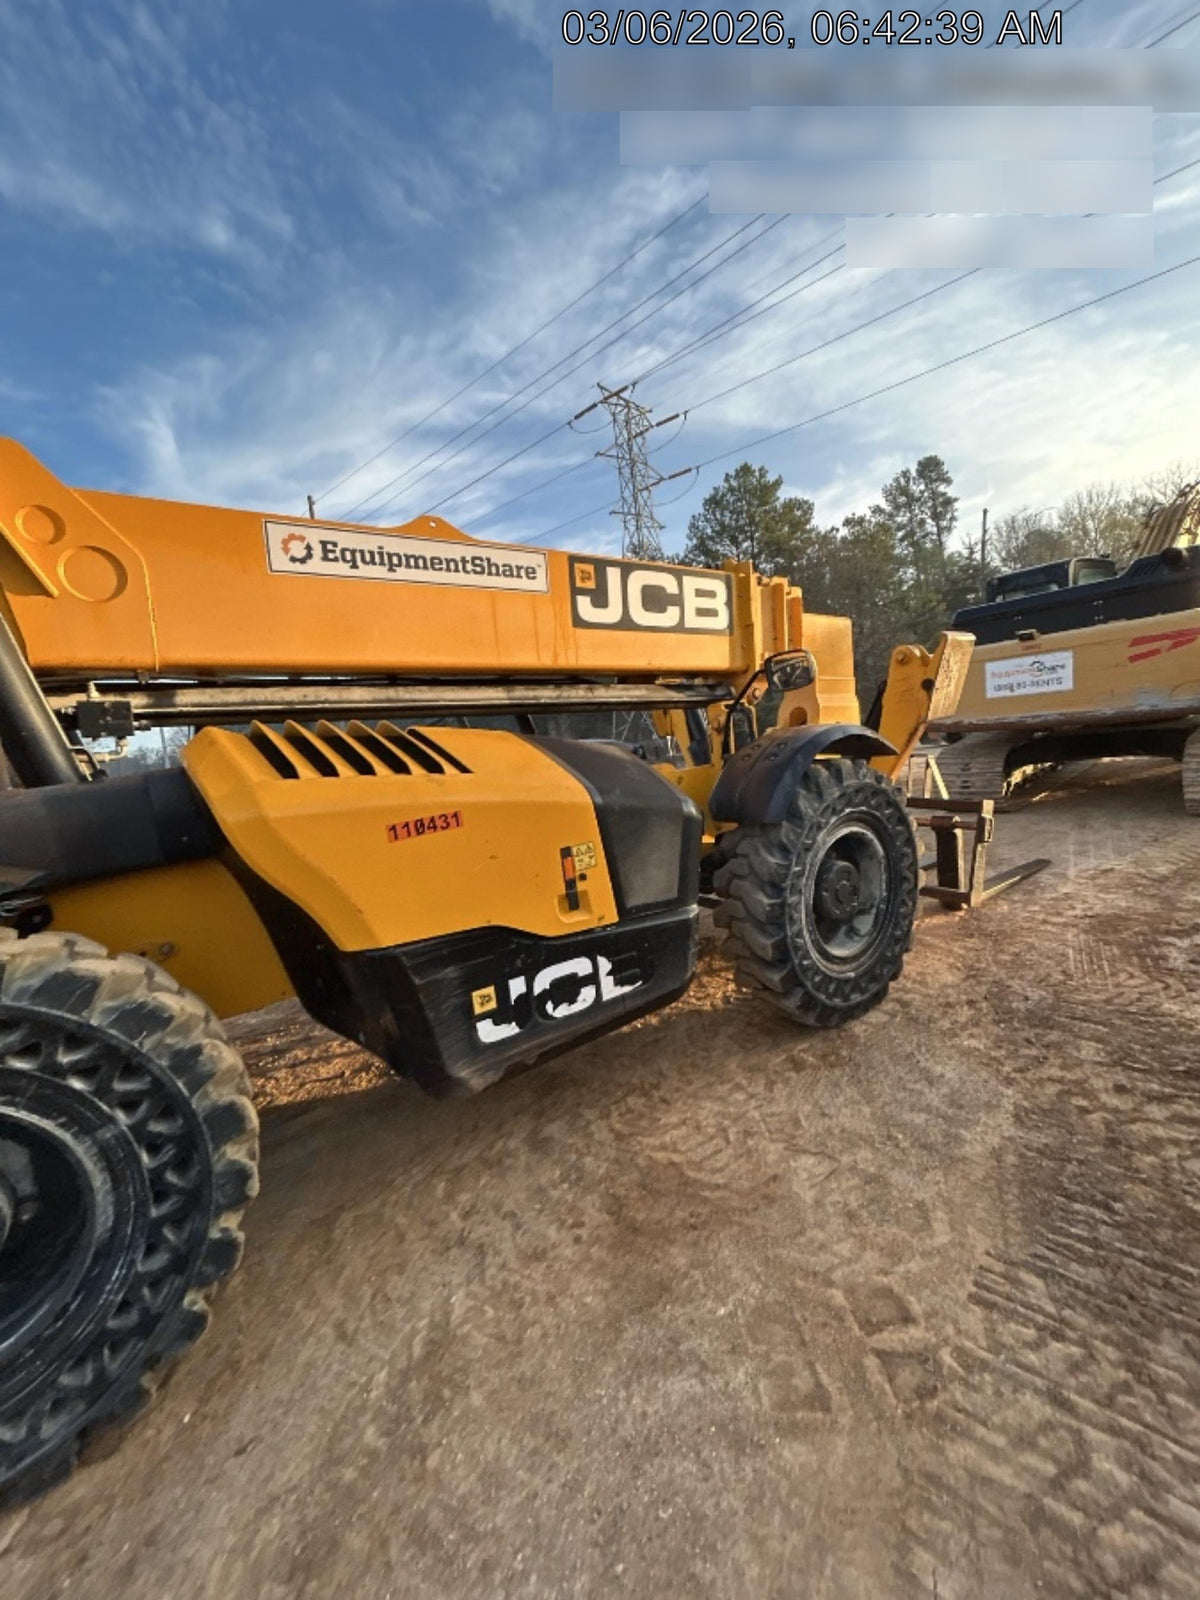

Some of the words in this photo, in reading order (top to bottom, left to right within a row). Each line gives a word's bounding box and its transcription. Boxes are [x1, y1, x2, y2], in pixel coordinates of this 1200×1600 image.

[318, 540, 538, 581] EquipmentShare
[575, 566, 729, 630] JCB
[388, 811, 462, 841] 110431
